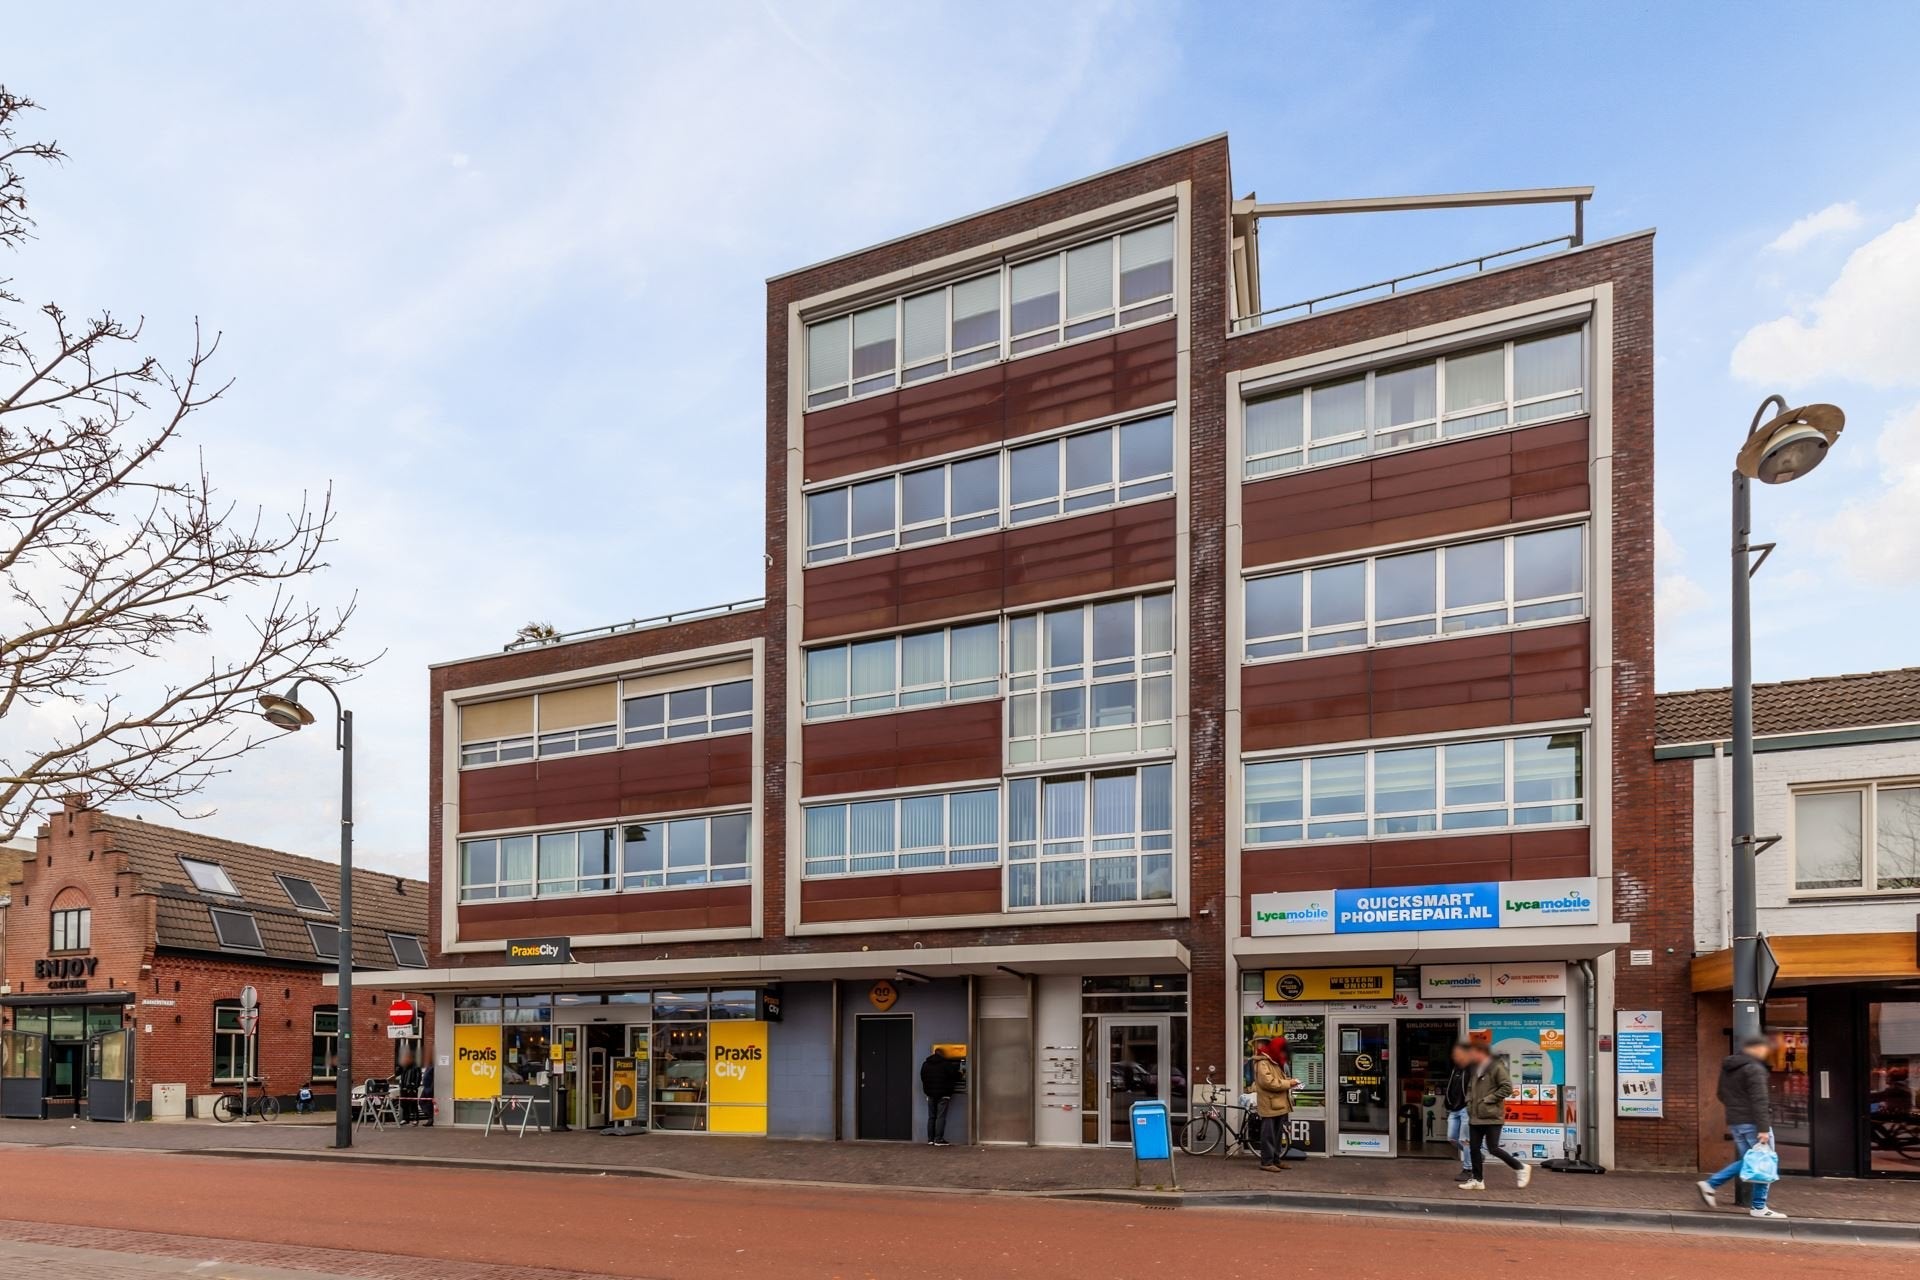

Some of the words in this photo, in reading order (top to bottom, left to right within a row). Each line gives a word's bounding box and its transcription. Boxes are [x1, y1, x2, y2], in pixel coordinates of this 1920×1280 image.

[1357, 892, 1475, 910] QUICKSMART
[1506, 896, 1591, 912] Lycamobile
[1256, 908, 1329, 922] Lycamobile
[1341, 905, 1493, 924] PHONEREPAIR.NL
[511, 943, 559, 958] PraxisCity
[35, 956, 98, 979] ENJOY
[1330, 976, 1374, 984] WESTERN
[1429, 977, 1481, 986] Lycamobile
[458, 1046, 497, 1061] Praxis
[715, 1045, 762, 1061] Praxis
[471, 1061, 497, 1079] City
[715, 1061, 746, 1081] City
[1525, 1127, 1561, 1135] SERVICE
